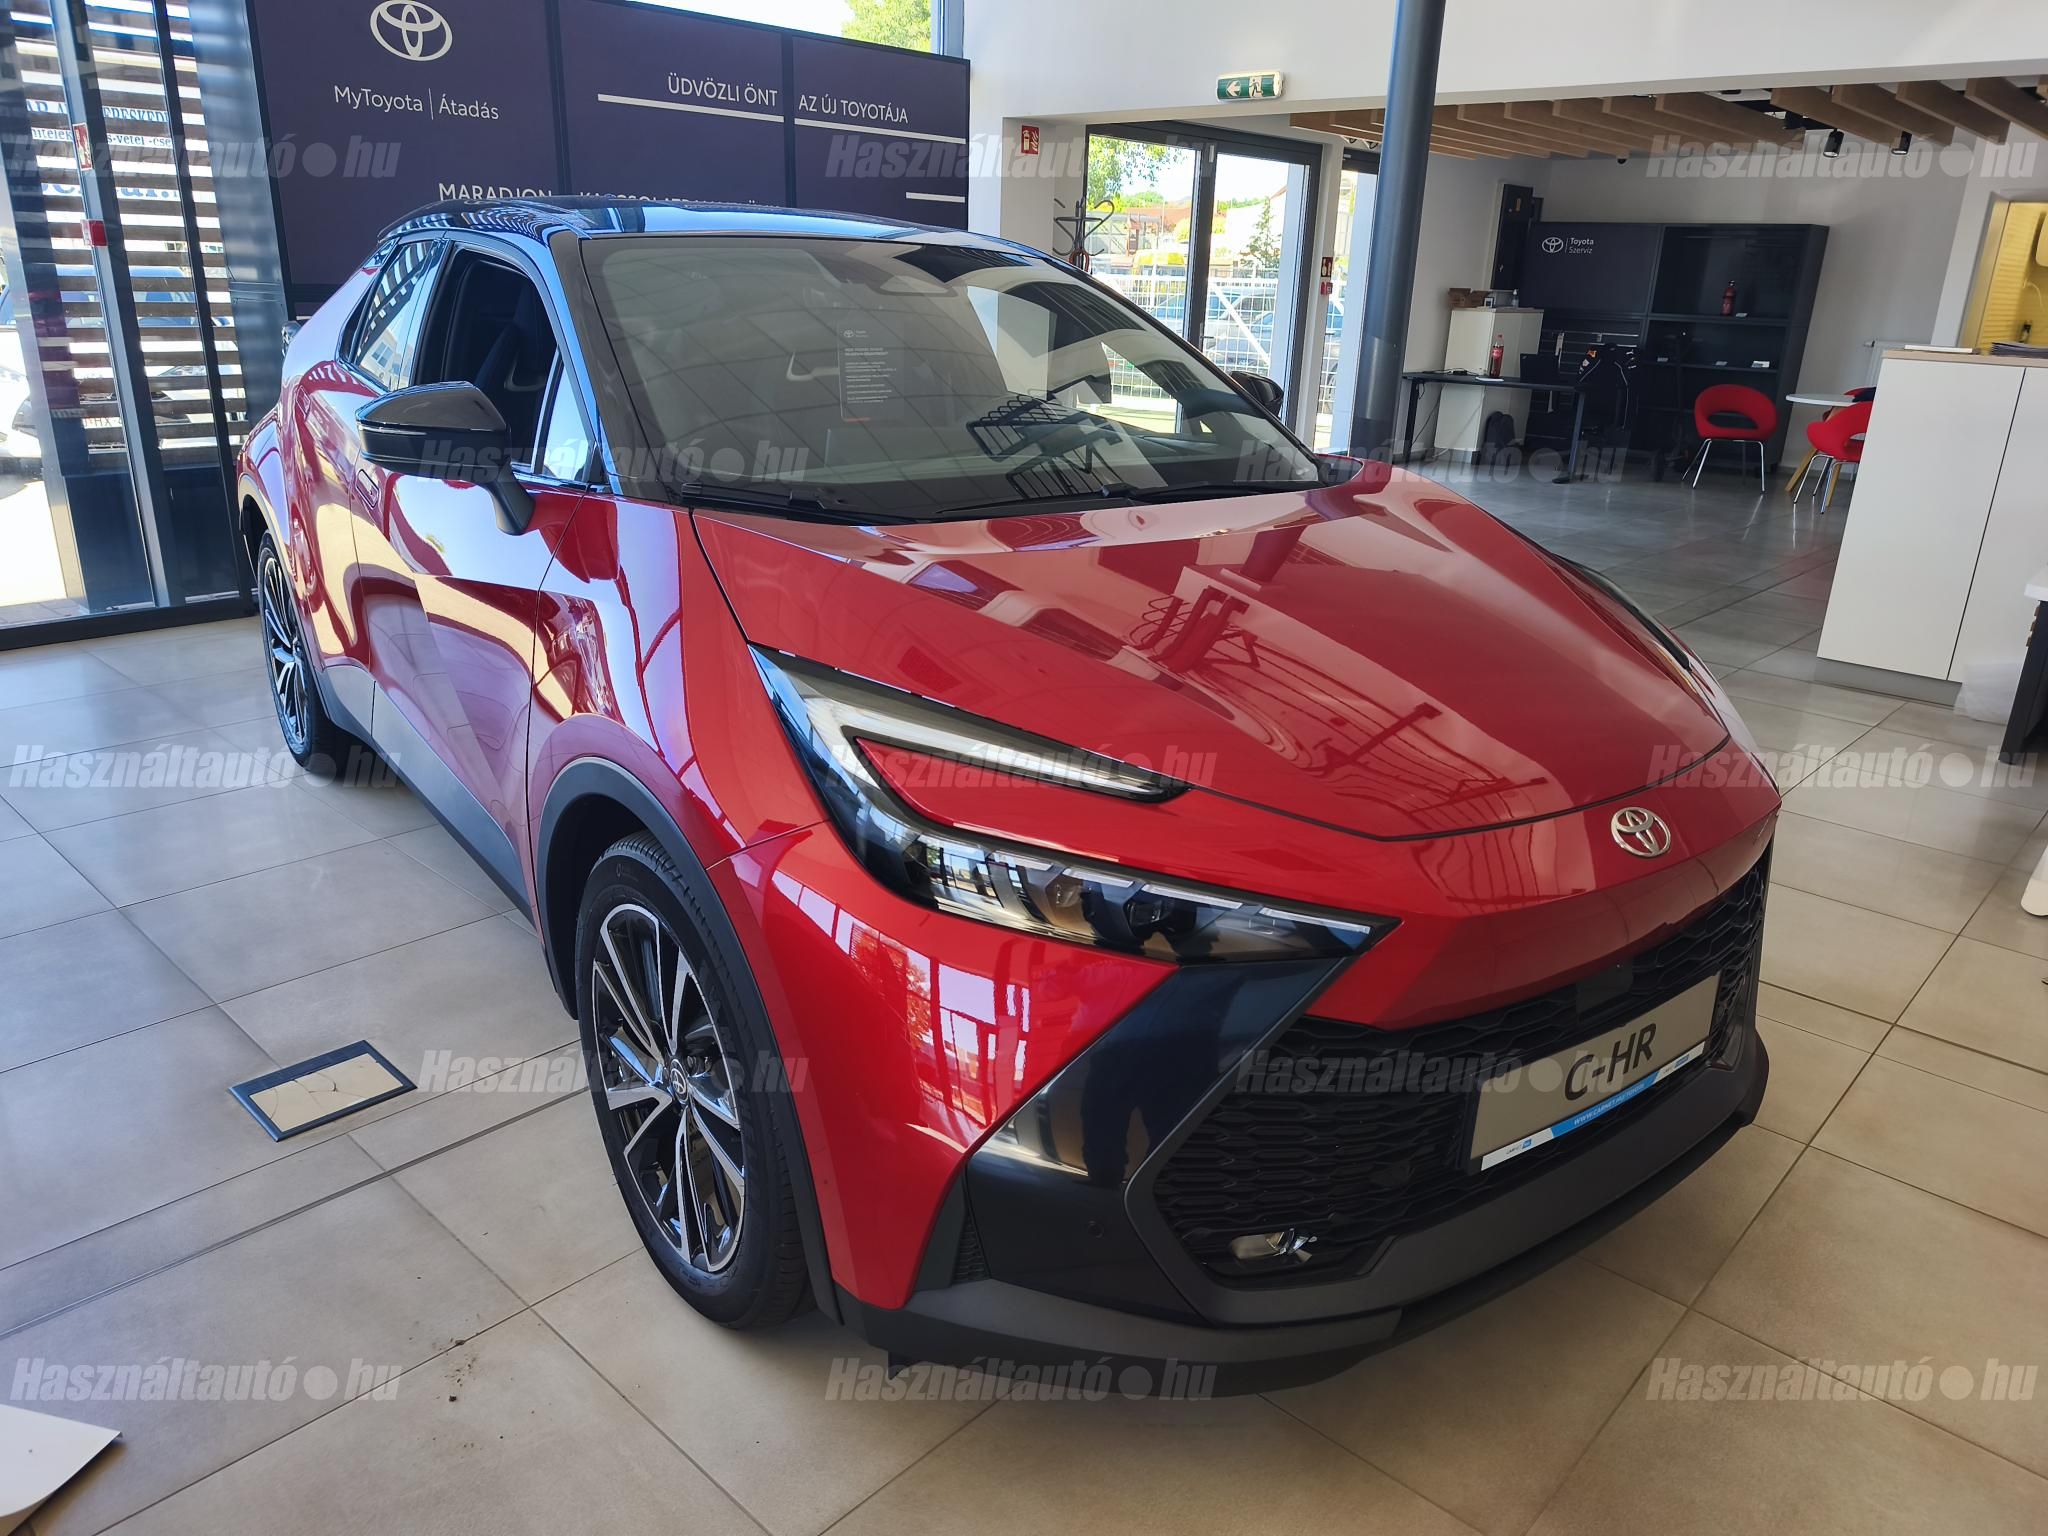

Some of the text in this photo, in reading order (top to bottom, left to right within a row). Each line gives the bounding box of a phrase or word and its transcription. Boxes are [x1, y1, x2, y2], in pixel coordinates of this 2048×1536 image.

[334, 85, 499, 120] MyToyota Átadás
[668, 72, 909, 124] ÜDVÖZLI ÖNT AZ ÚJ TOYOTÁJA
[1569, 237, 1594, 246] Toyota
[1564, 1023, 1657, 1101] C-HR
